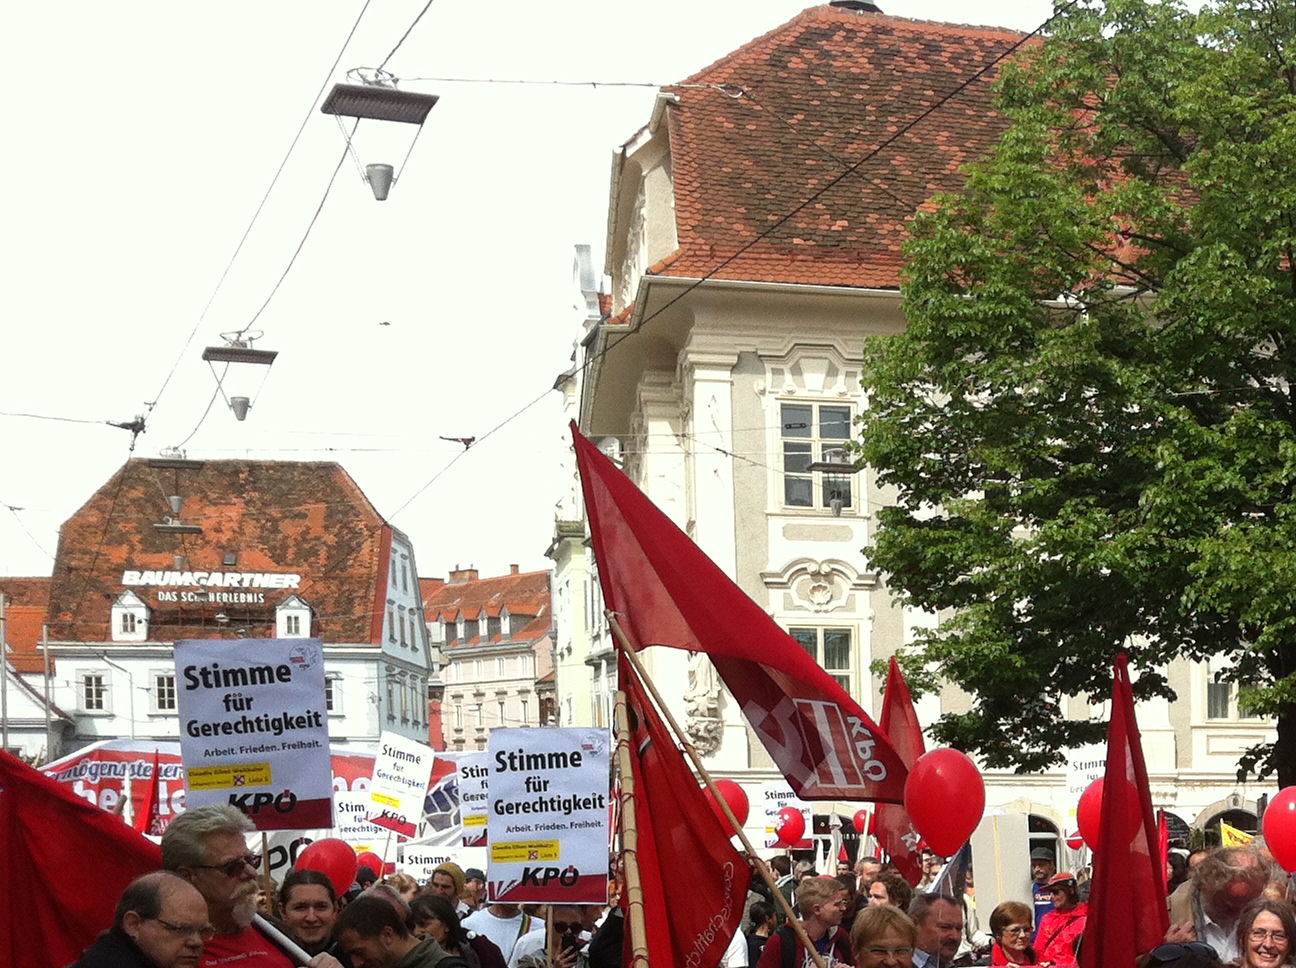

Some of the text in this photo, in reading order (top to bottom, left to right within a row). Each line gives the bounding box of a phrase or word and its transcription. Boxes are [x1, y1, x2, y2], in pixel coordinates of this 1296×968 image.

[122, 570, 301, 589] BAUMGARTNER
[158, 590, 178, 602] DAS
[183, 662, 292, 691] Stimme
[222, 692, 254, 713] für
[187, 709, 323, 738] Gerechtigkeit
[203, 740, 323, 758] Arbeit. Frieden. Freiheit.
[381, 743, 422, 765] Stimme
[495, 748, 582, 773] Stimme
[376, 769, 425, 790] Gerechtigkeit
[524, 776, 550, 793] für
[228, 789, 298, 814] KPÖ
[494, 792, 606, 815] Gerechtigkeit
[506, 820, 604, 833] Arbeit. Frieden. Freiheit.
[408, 854, 451, 865] Stimme
[521, 865, 580, 887] KPÖ
